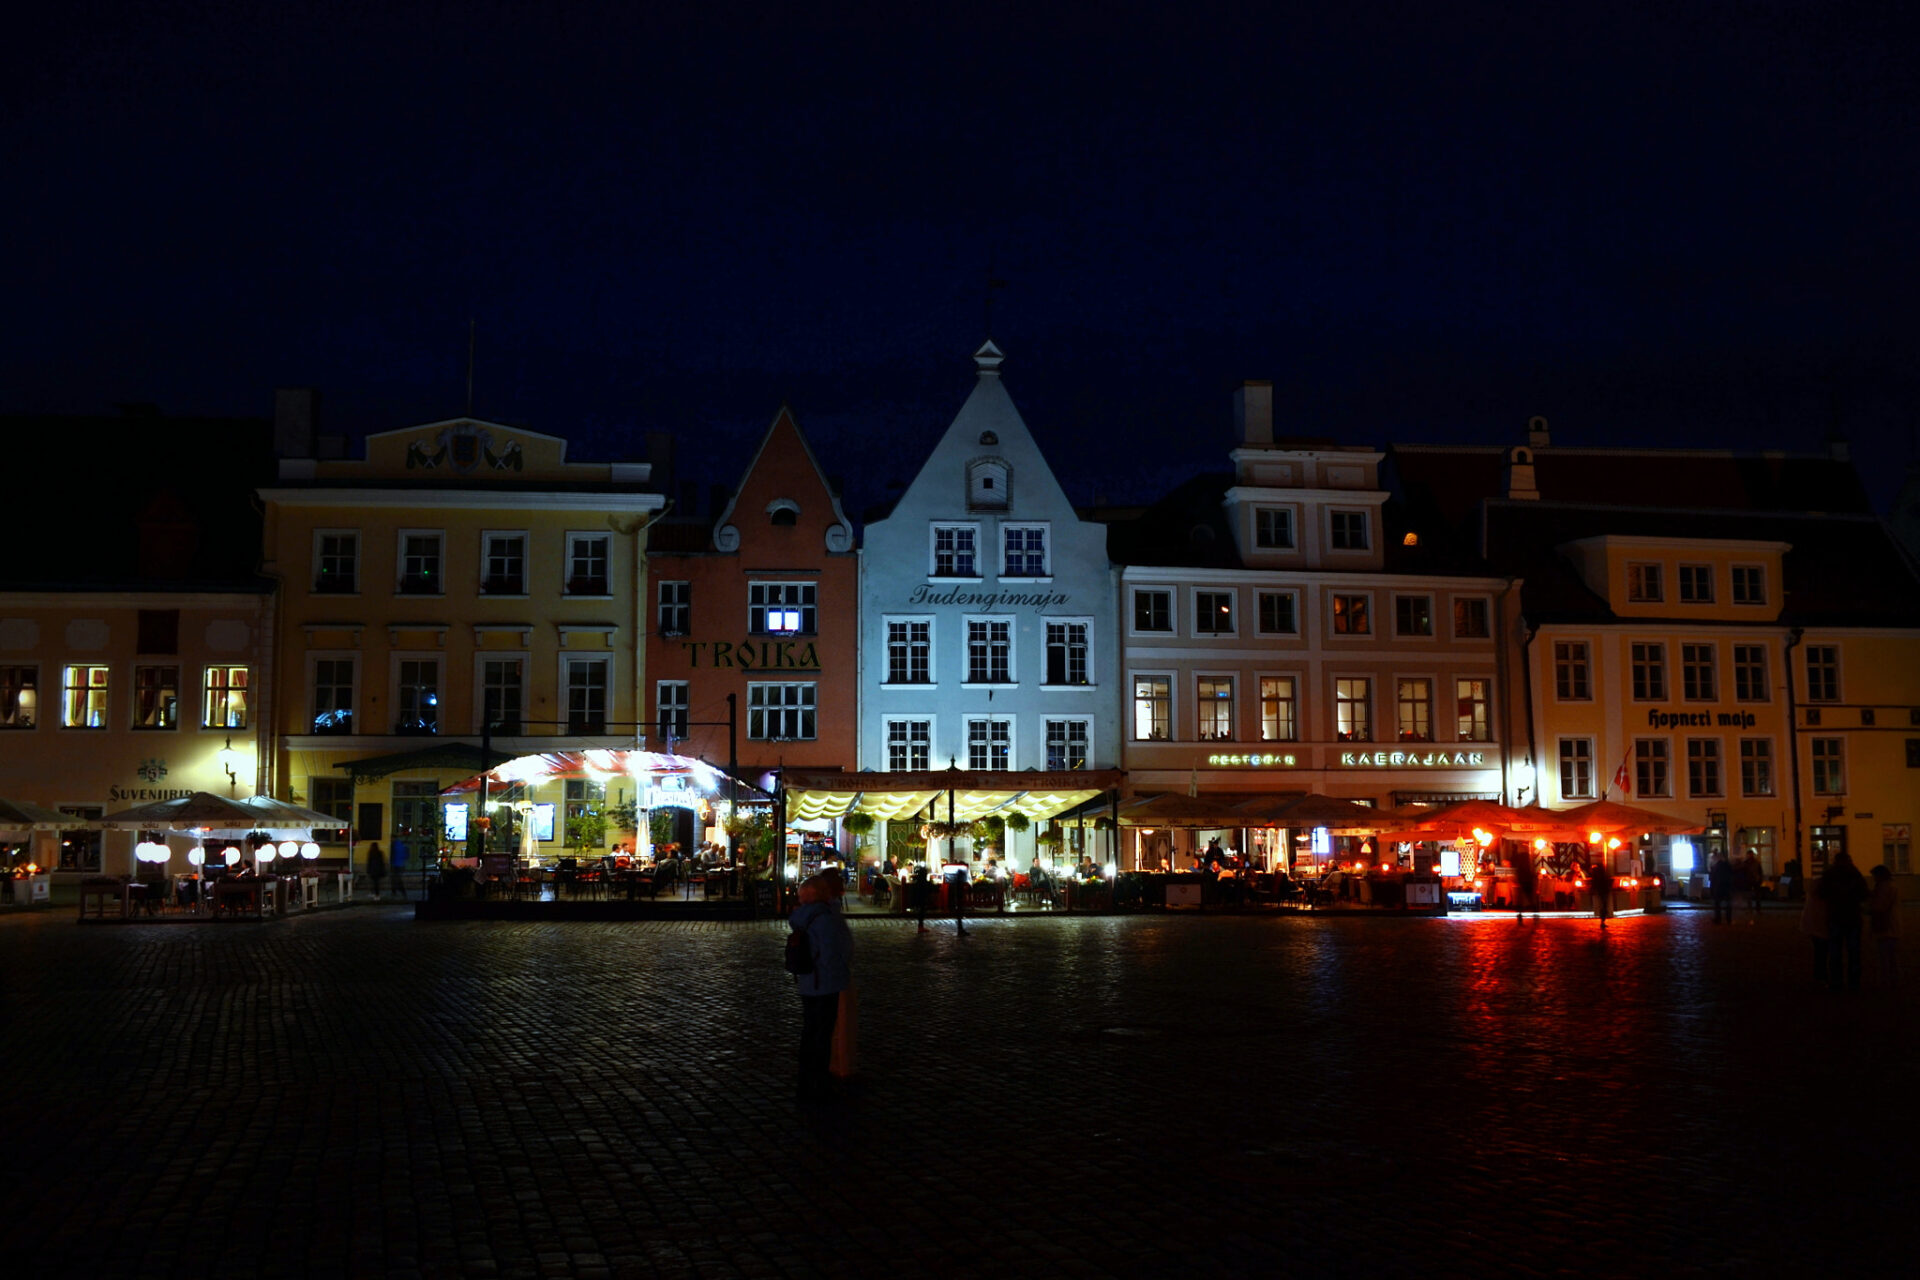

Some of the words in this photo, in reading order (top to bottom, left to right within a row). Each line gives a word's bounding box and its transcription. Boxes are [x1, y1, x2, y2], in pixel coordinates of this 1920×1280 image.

[910, 584, 1070, 613] Tudengimaja
[682, 641, 820, 668] TROIKA
[1648, 709, 1711, 729] Hopneri
[1717, 710, 1755, 729] maja
[1341, 752, 1483, 765] KAERAJAAN
